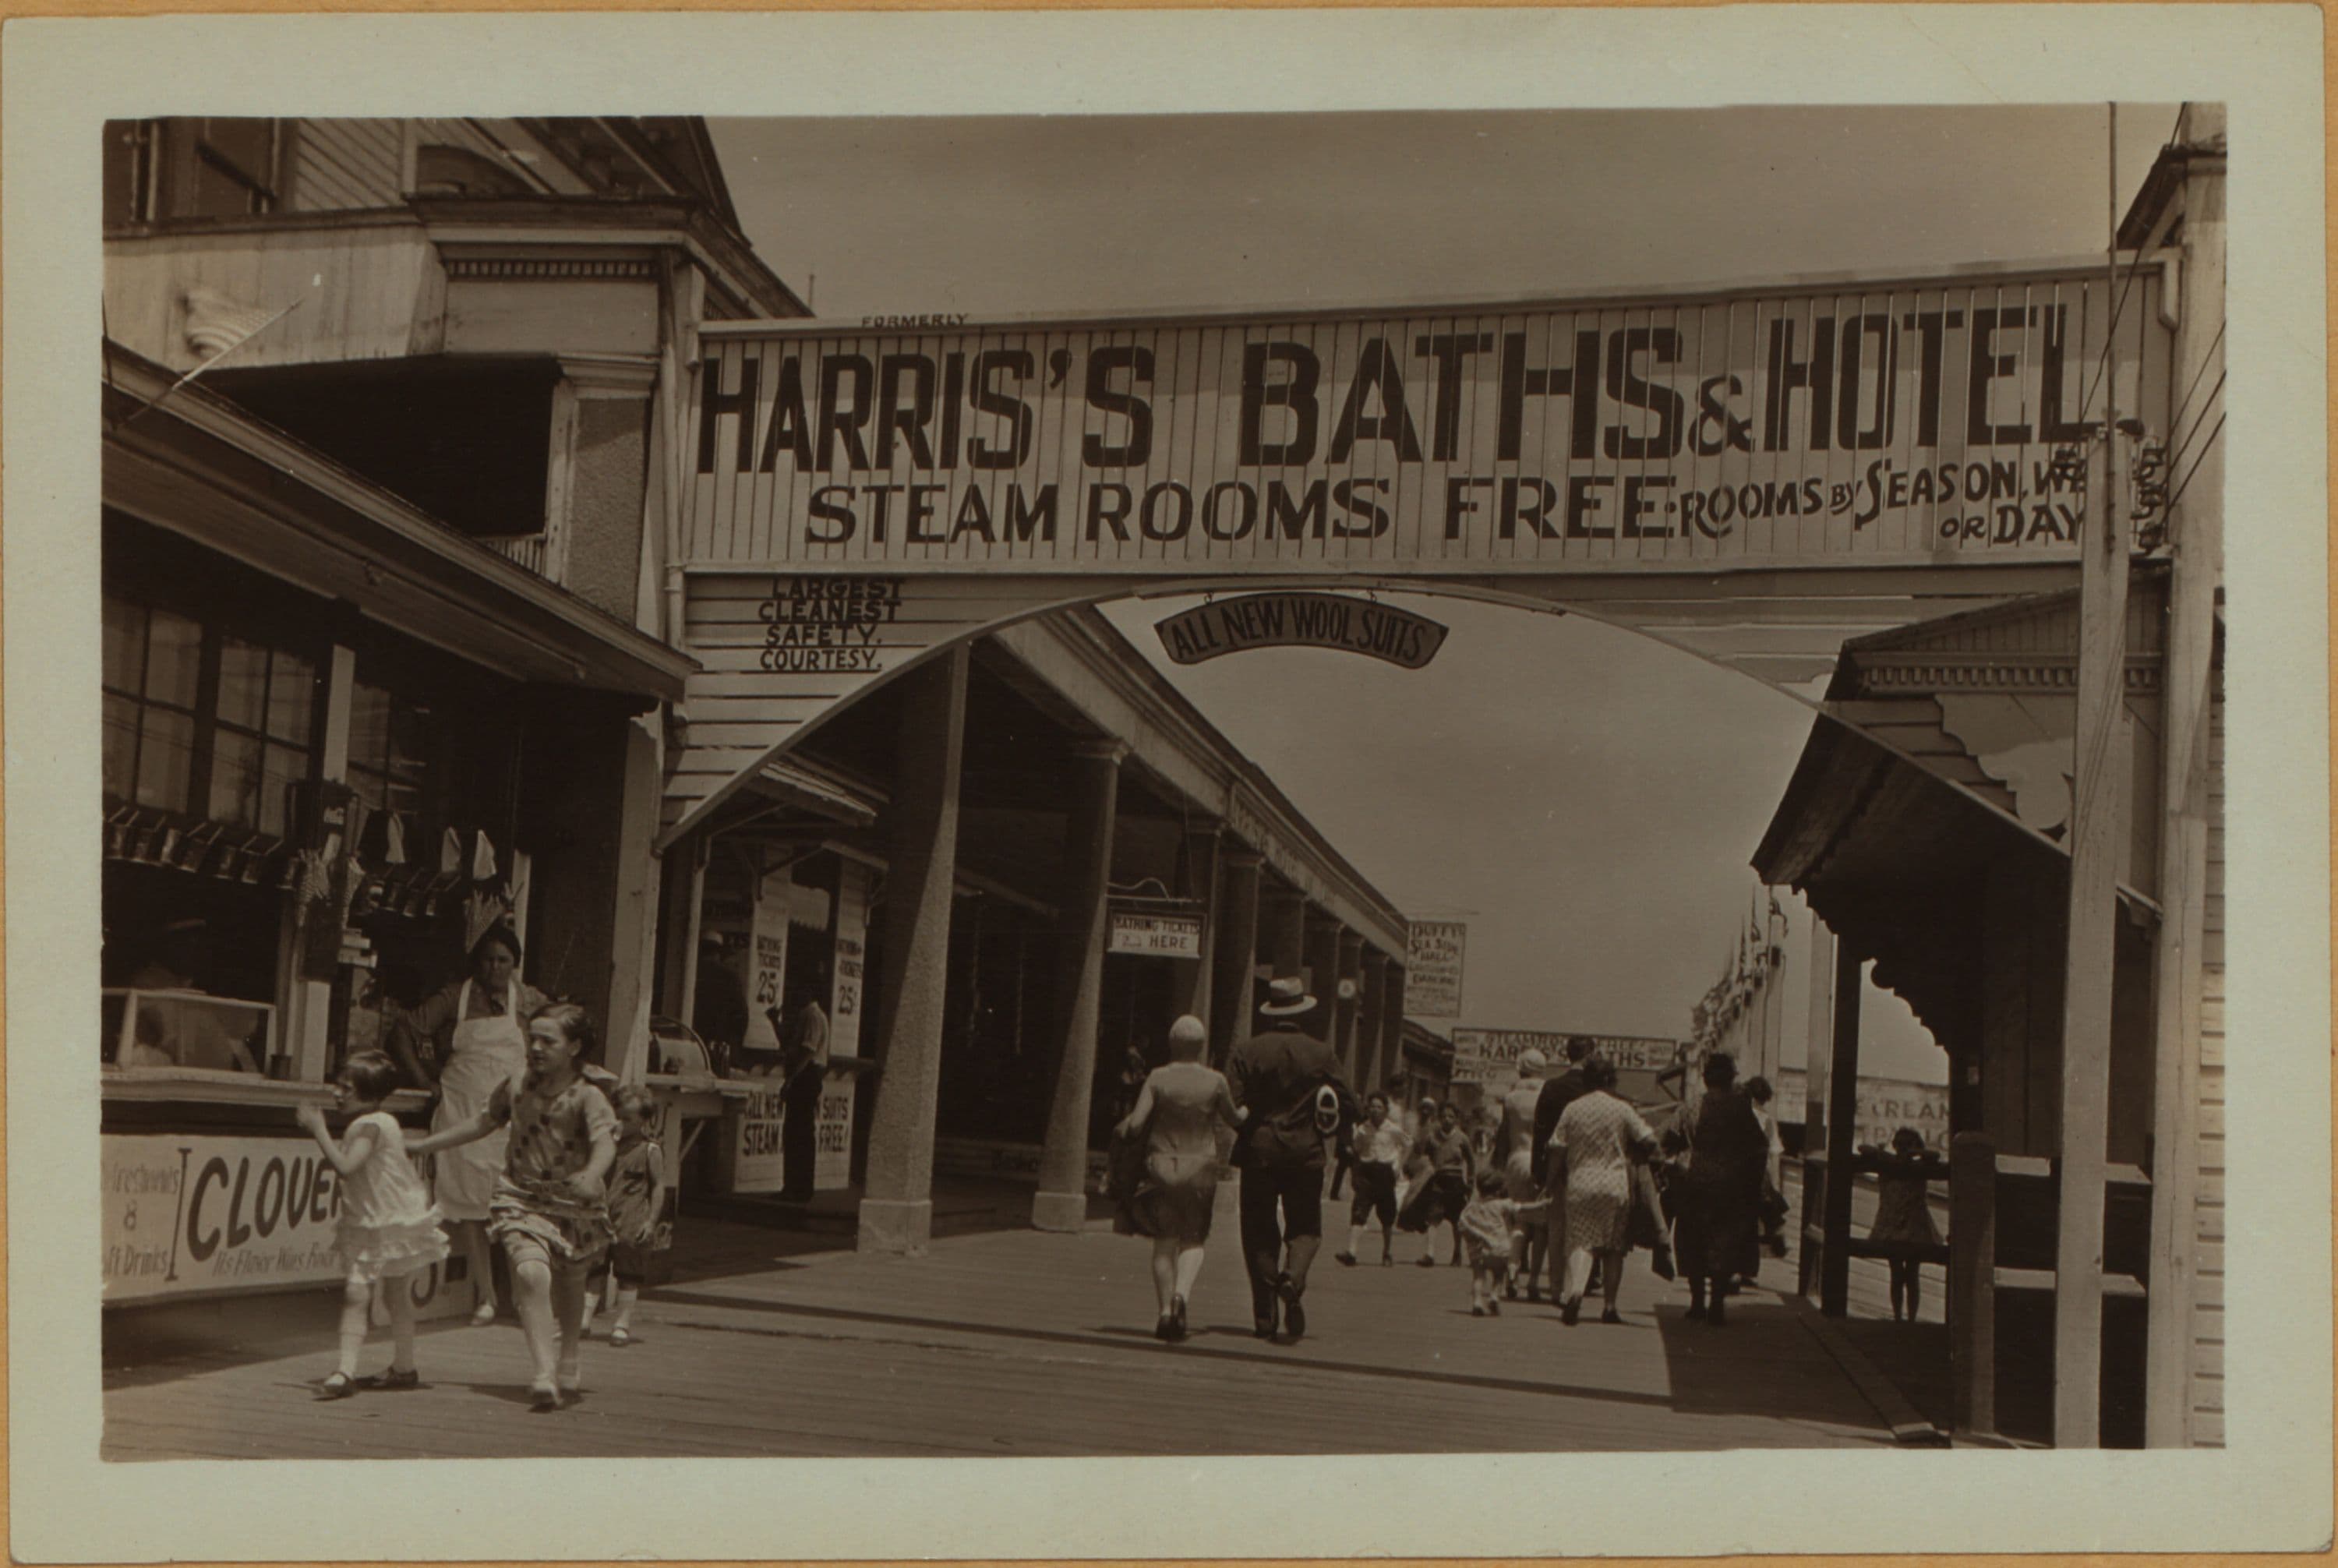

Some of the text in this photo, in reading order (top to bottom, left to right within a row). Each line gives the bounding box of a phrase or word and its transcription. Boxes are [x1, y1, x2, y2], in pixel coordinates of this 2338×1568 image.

[862, 313, 968, 330] FORMERLY
[698, 304, 2107, 474] HARRIS'S BATHS & HOTEL
[804, 475, 1677, 544] STEAM ROOMS FREE
[1681, 477, 1823, 539] ROOMS
[1828, 480, 1863, 516] BY
[1939, 503, 2086, 544] OR DAY
[772, 577, 906, 599] LARGEST
[758, 599, 902, 622] CLEANEST
[1171, 598, 1428, 662] ALL NEW WOOL SUITS
[1150, 937, 1188, 950] HERE
[742, 1122, 779, 1157] STEAM
